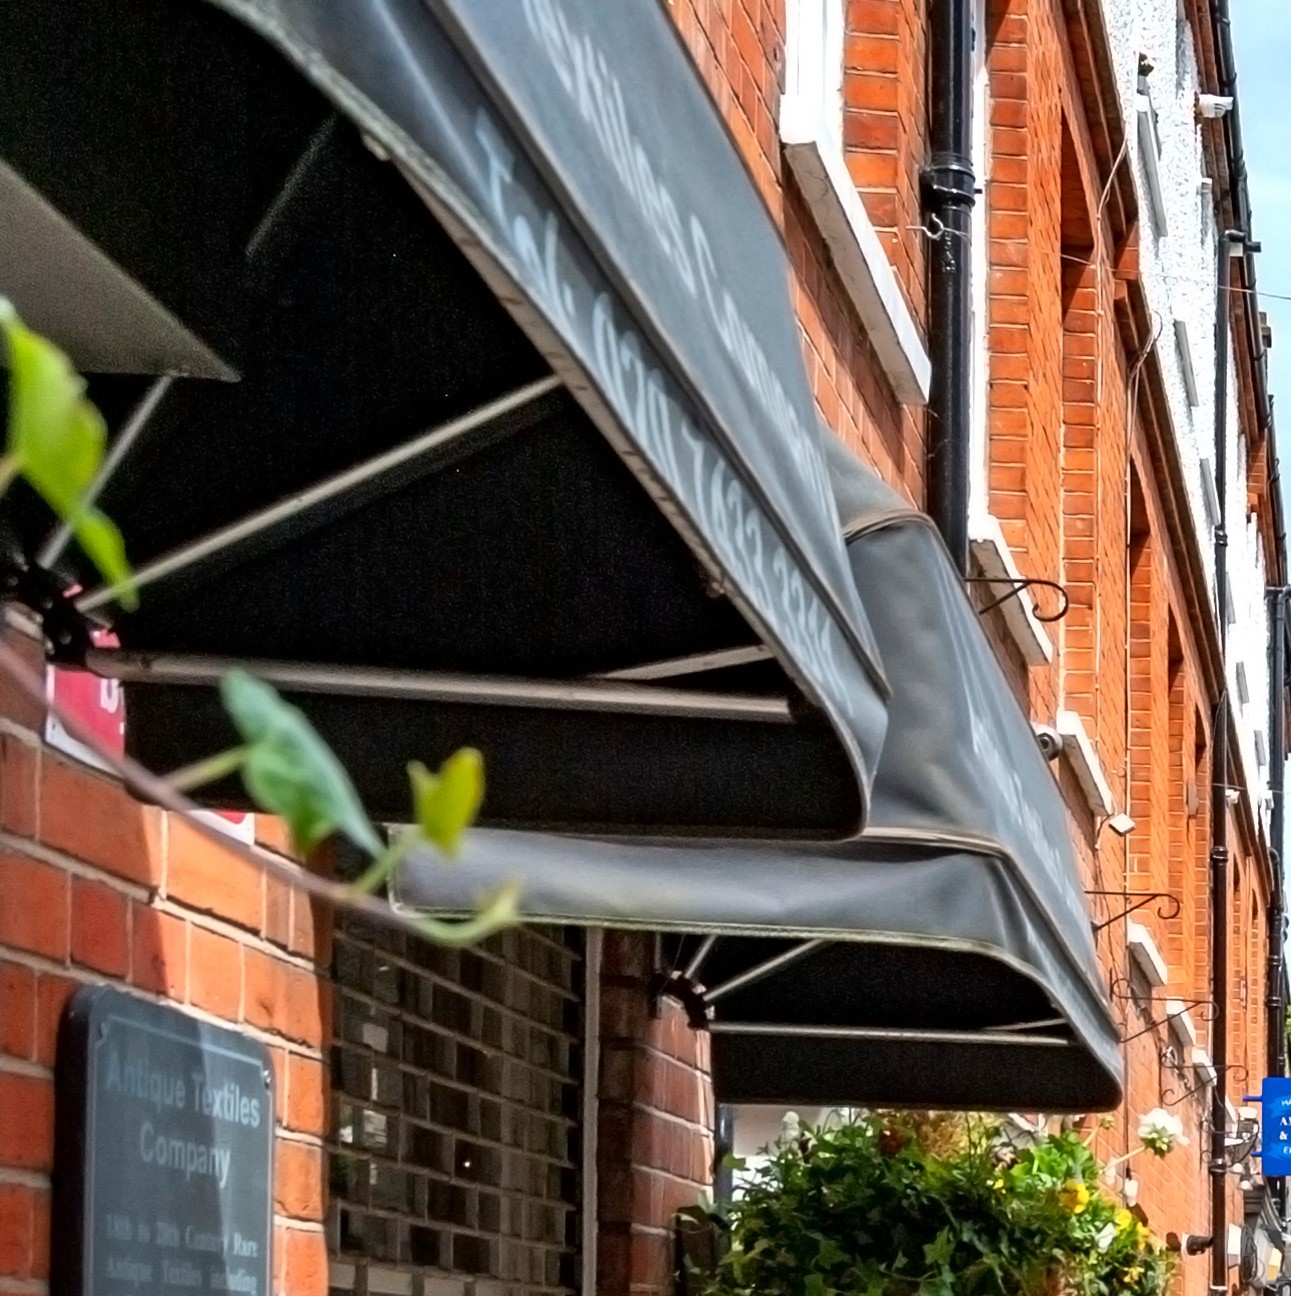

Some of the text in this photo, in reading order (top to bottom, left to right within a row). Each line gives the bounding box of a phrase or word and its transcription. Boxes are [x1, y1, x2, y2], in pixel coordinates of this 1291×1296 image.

[592, 291, 686, 495] 020
[682, 415, 780, 622] 7433
[105, 1050, 261, 1129] Antique Textiles
[139, 1121, 231, 1190] Company
[1279, 1130, 1288, 1140] &
[233, 1231, 258, 1258] Rare
